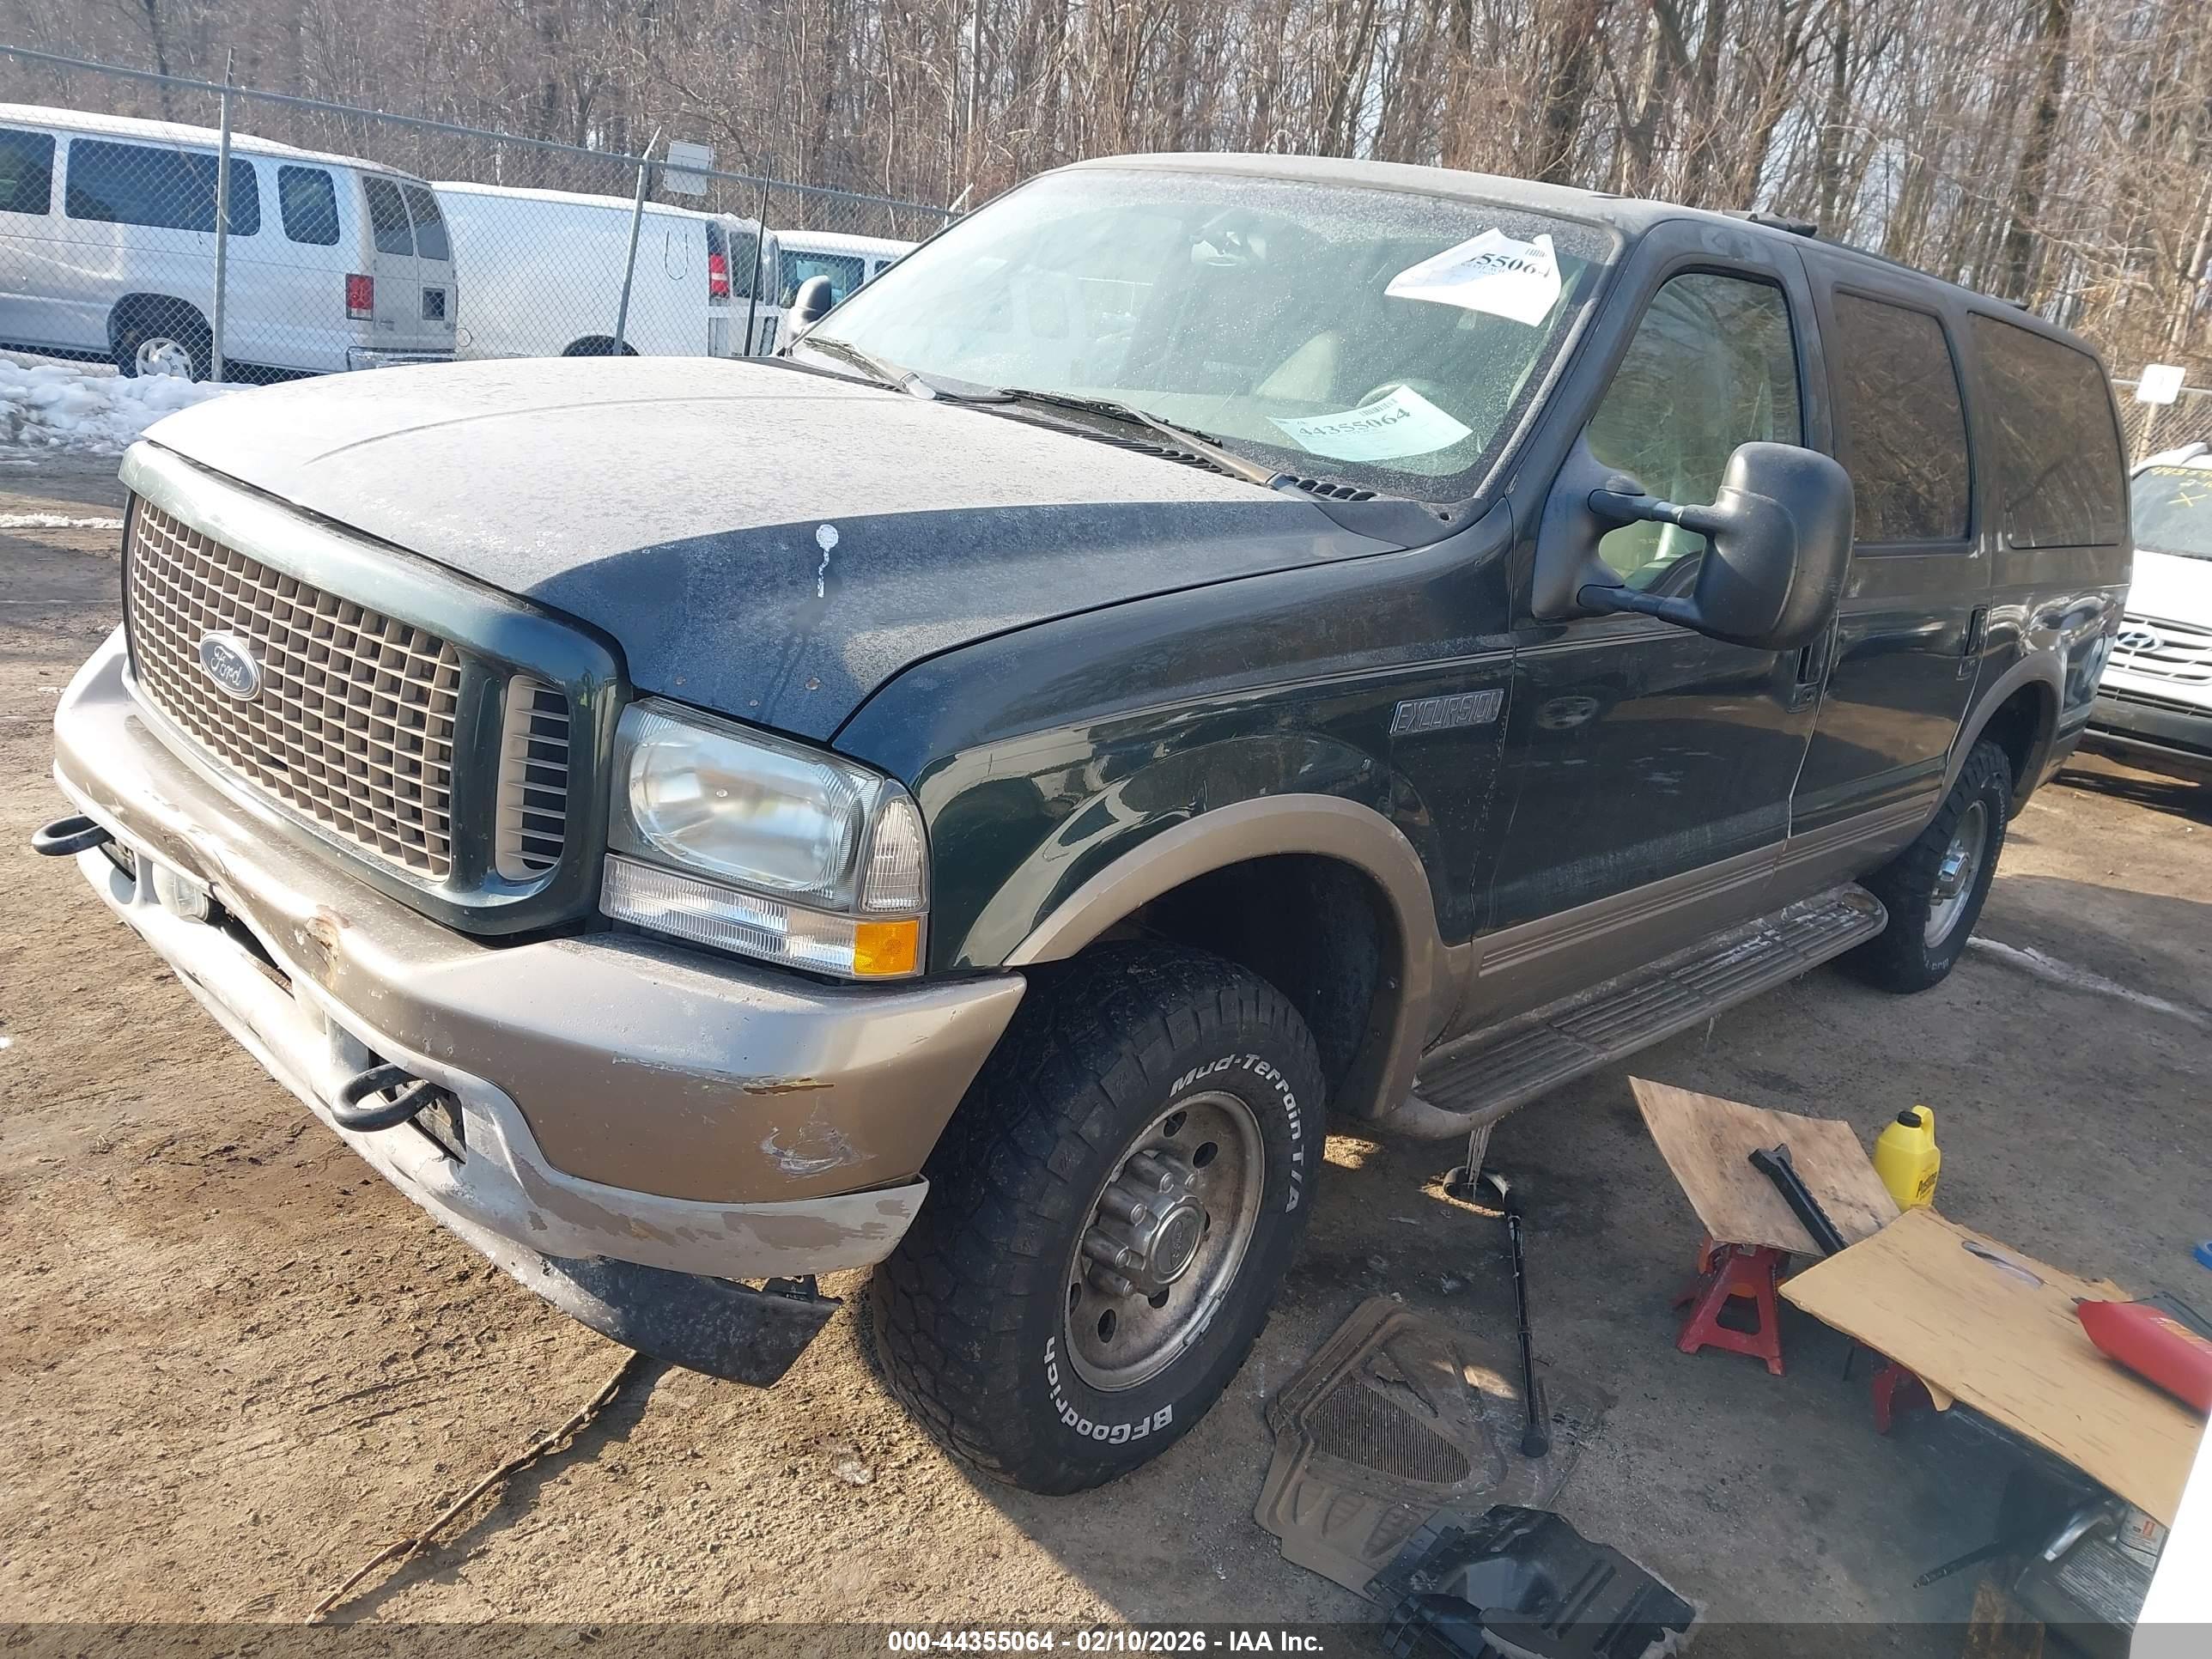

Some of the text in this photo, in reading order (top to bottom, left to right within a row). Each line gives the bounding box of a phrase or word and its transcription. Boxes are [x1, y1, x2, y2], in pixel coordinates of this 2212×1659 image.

[1299, 408, 1411, 435] 44355064
[210, 646, 242, 686] Ford
[1393, 690, 1504, 732] EXCURSION
[1170, 1054, 1304, 1213] Mud-Terrain T/A
[1043, 1336, 1173, 1444] BFGoodrich
